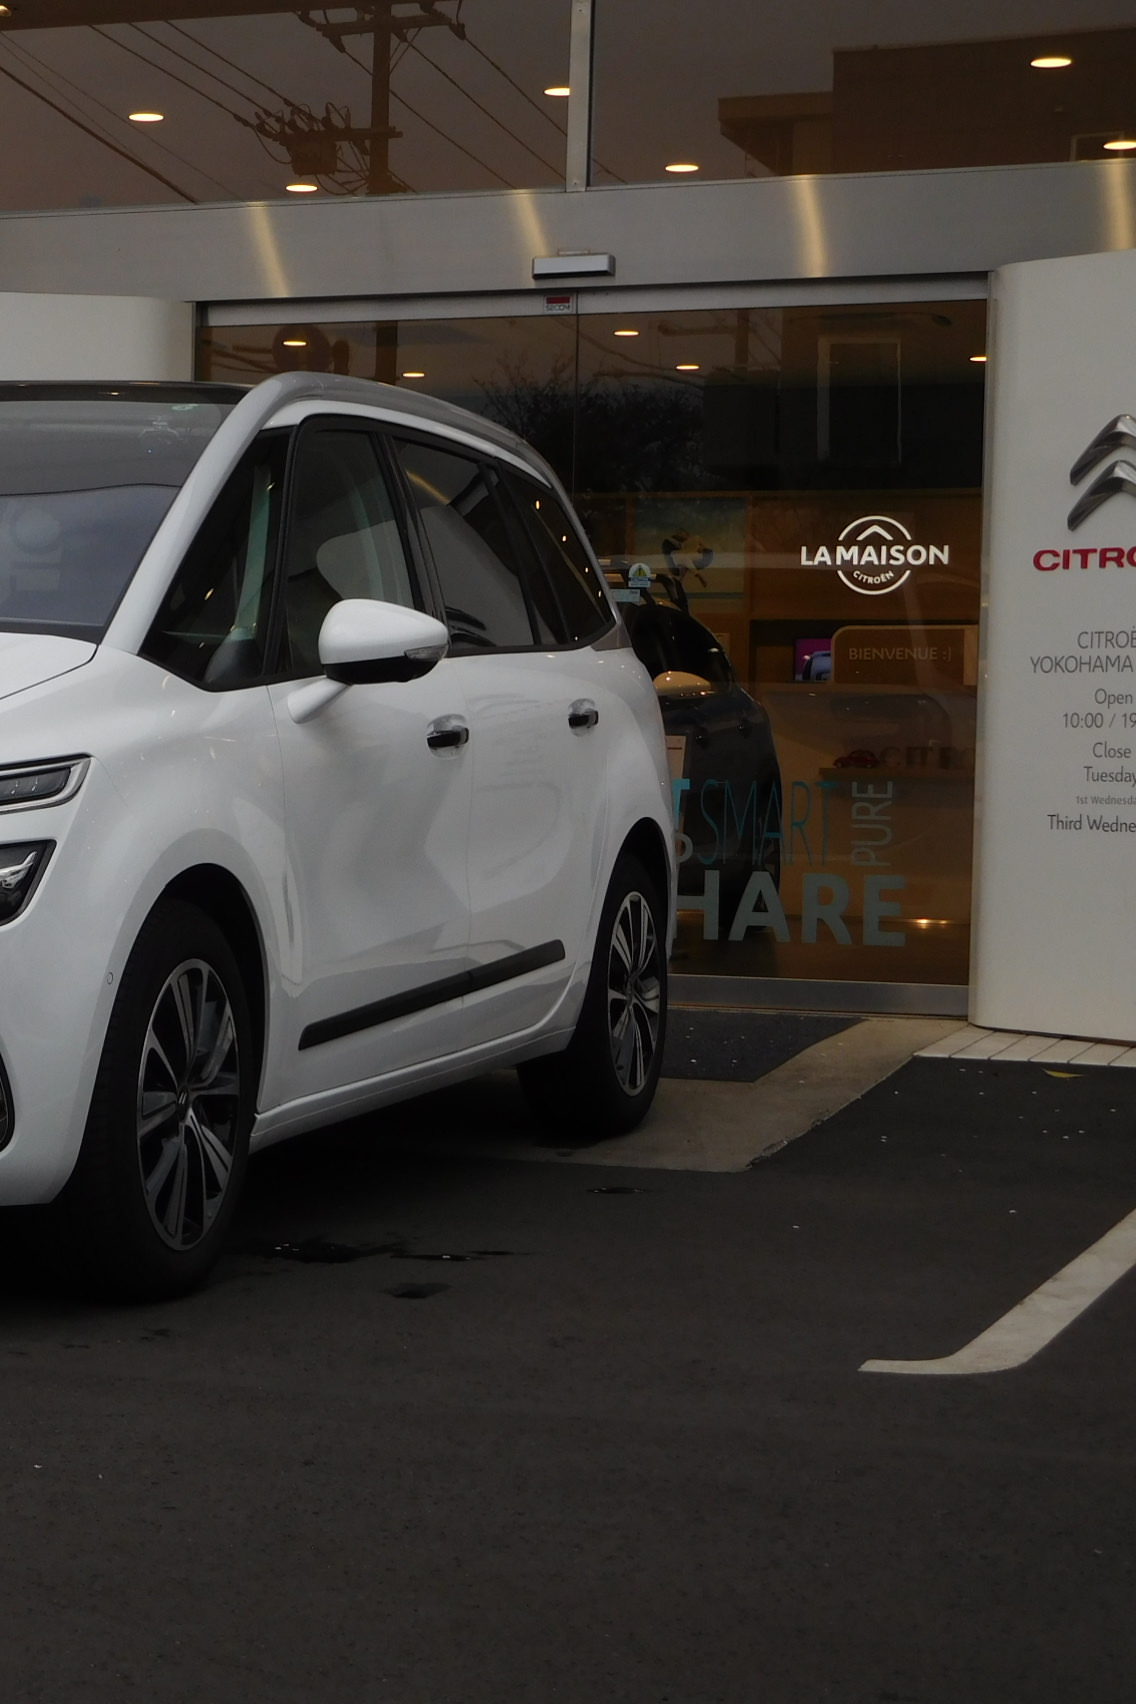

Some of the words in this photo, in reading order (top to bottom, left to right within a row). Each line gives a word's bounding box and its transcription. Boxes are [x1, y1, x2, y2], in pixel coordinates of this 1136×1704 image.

[852, 570, 894, 585] CITROËN
[848, 647, 937, 661] BIENVENUE
[1030, 655, 1134, 674] YOKOHAMA
[1094, 688, 1133, 709] Open
[1063, 713, 1104, 729] 10:00
[1092, 741, 1132, 759] Close
[1076, 796, 1088, 805] 1st
[697, 778, 841, 867] SMART
[850, 780, 894, 867] PURE
[1047, 813, 1083, 831] Third
